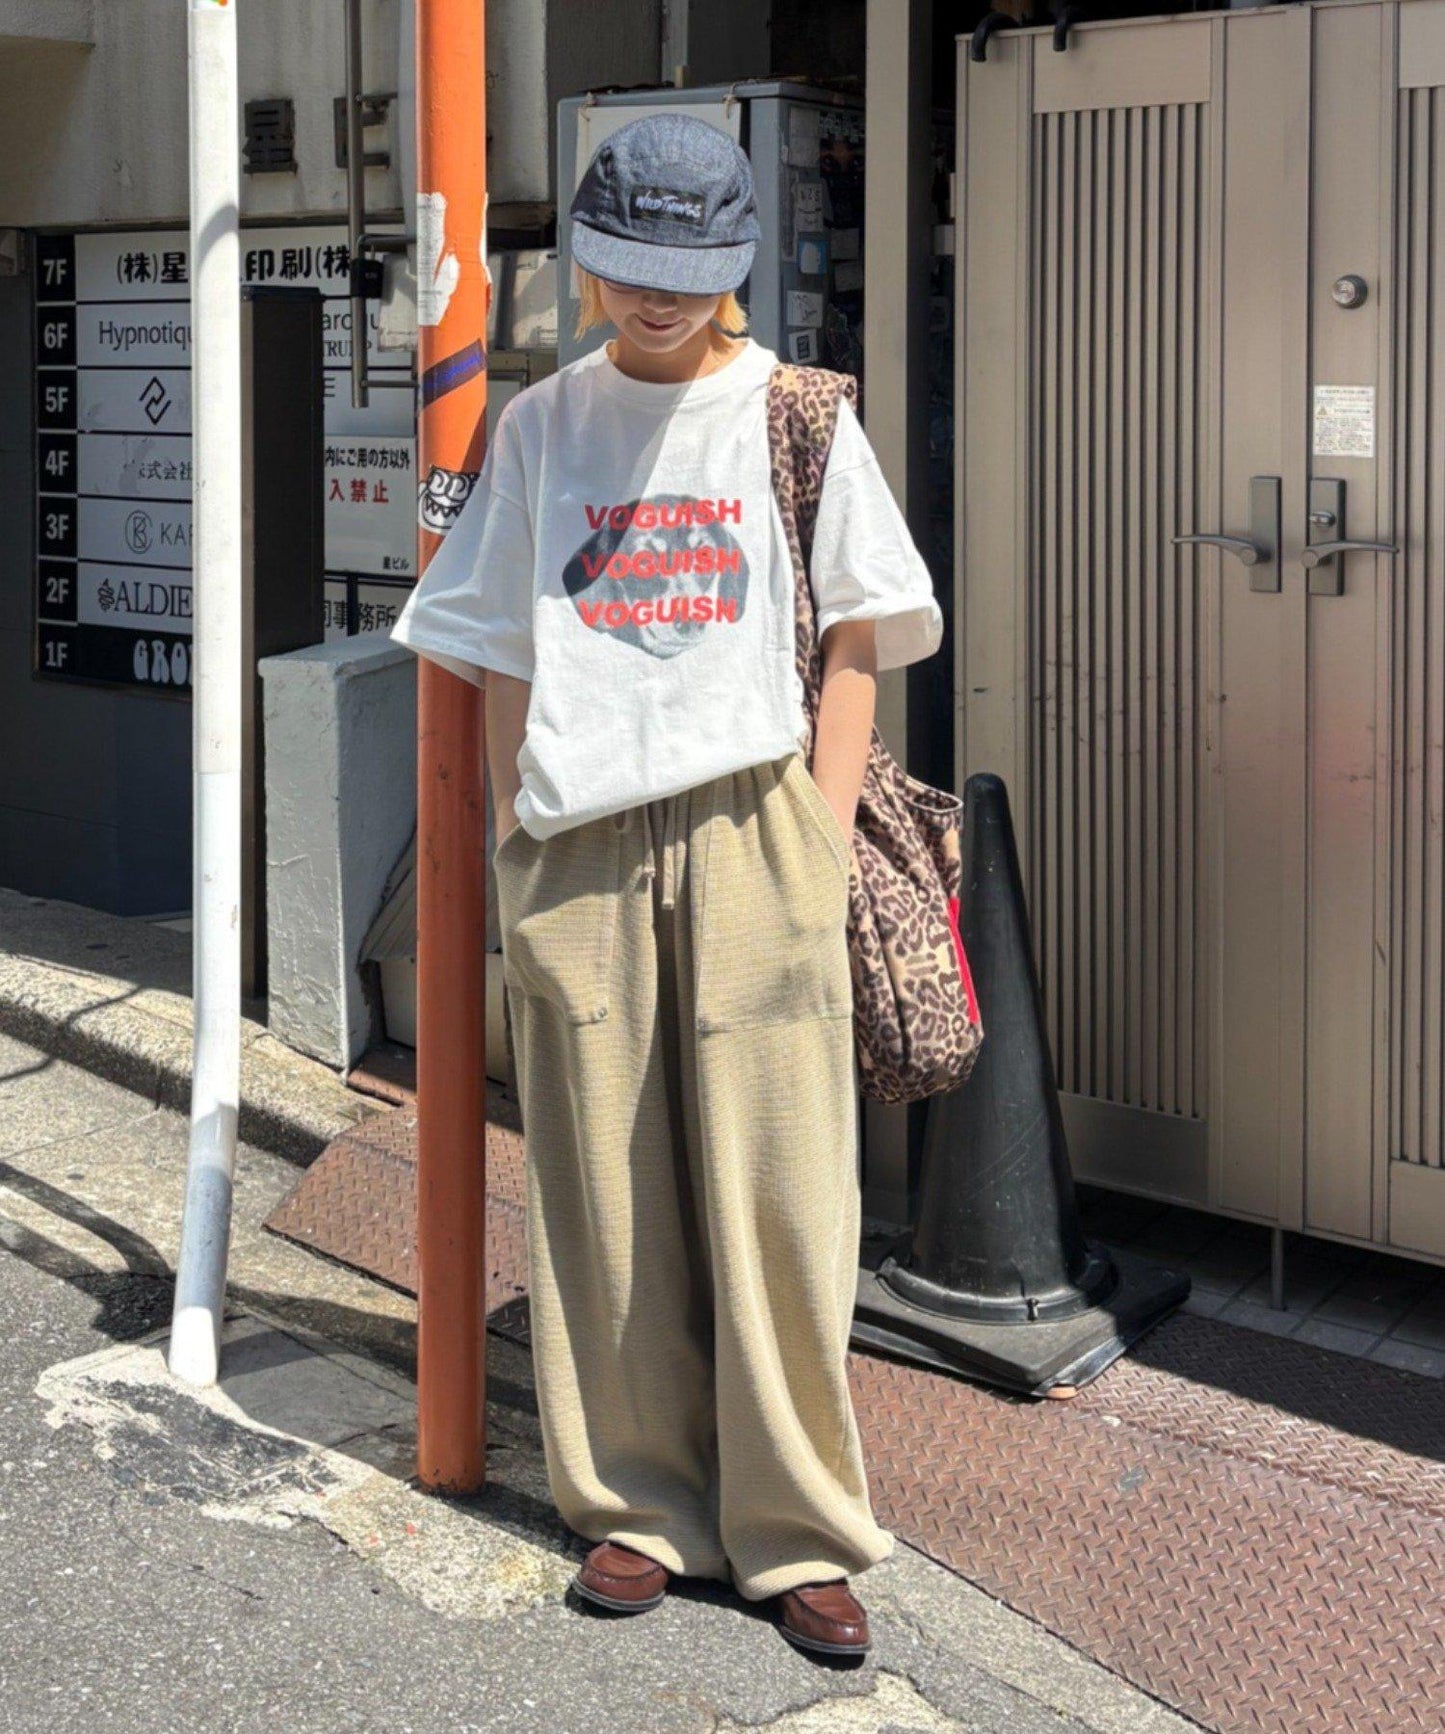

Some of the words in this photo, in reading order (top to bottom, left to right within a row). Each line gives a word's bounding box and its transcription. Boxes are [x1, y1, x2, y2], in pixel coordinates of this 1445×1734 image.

[44, 259, 67, 286] 7F
[44, 322, 68, 349] 6F
[45, 386, 68, 413] 5F
[45, 450, 69, 477] 4F
[328, 478, 390, 504] 入禁止
[46, 513, 69, 541] 3F
[584, 498, 743, 531] VOGUISH
[581, 545, 741, 580] VOGUISH
[46, 577, 69, 604] 2F
[46, 642, 68, 668] 1F
